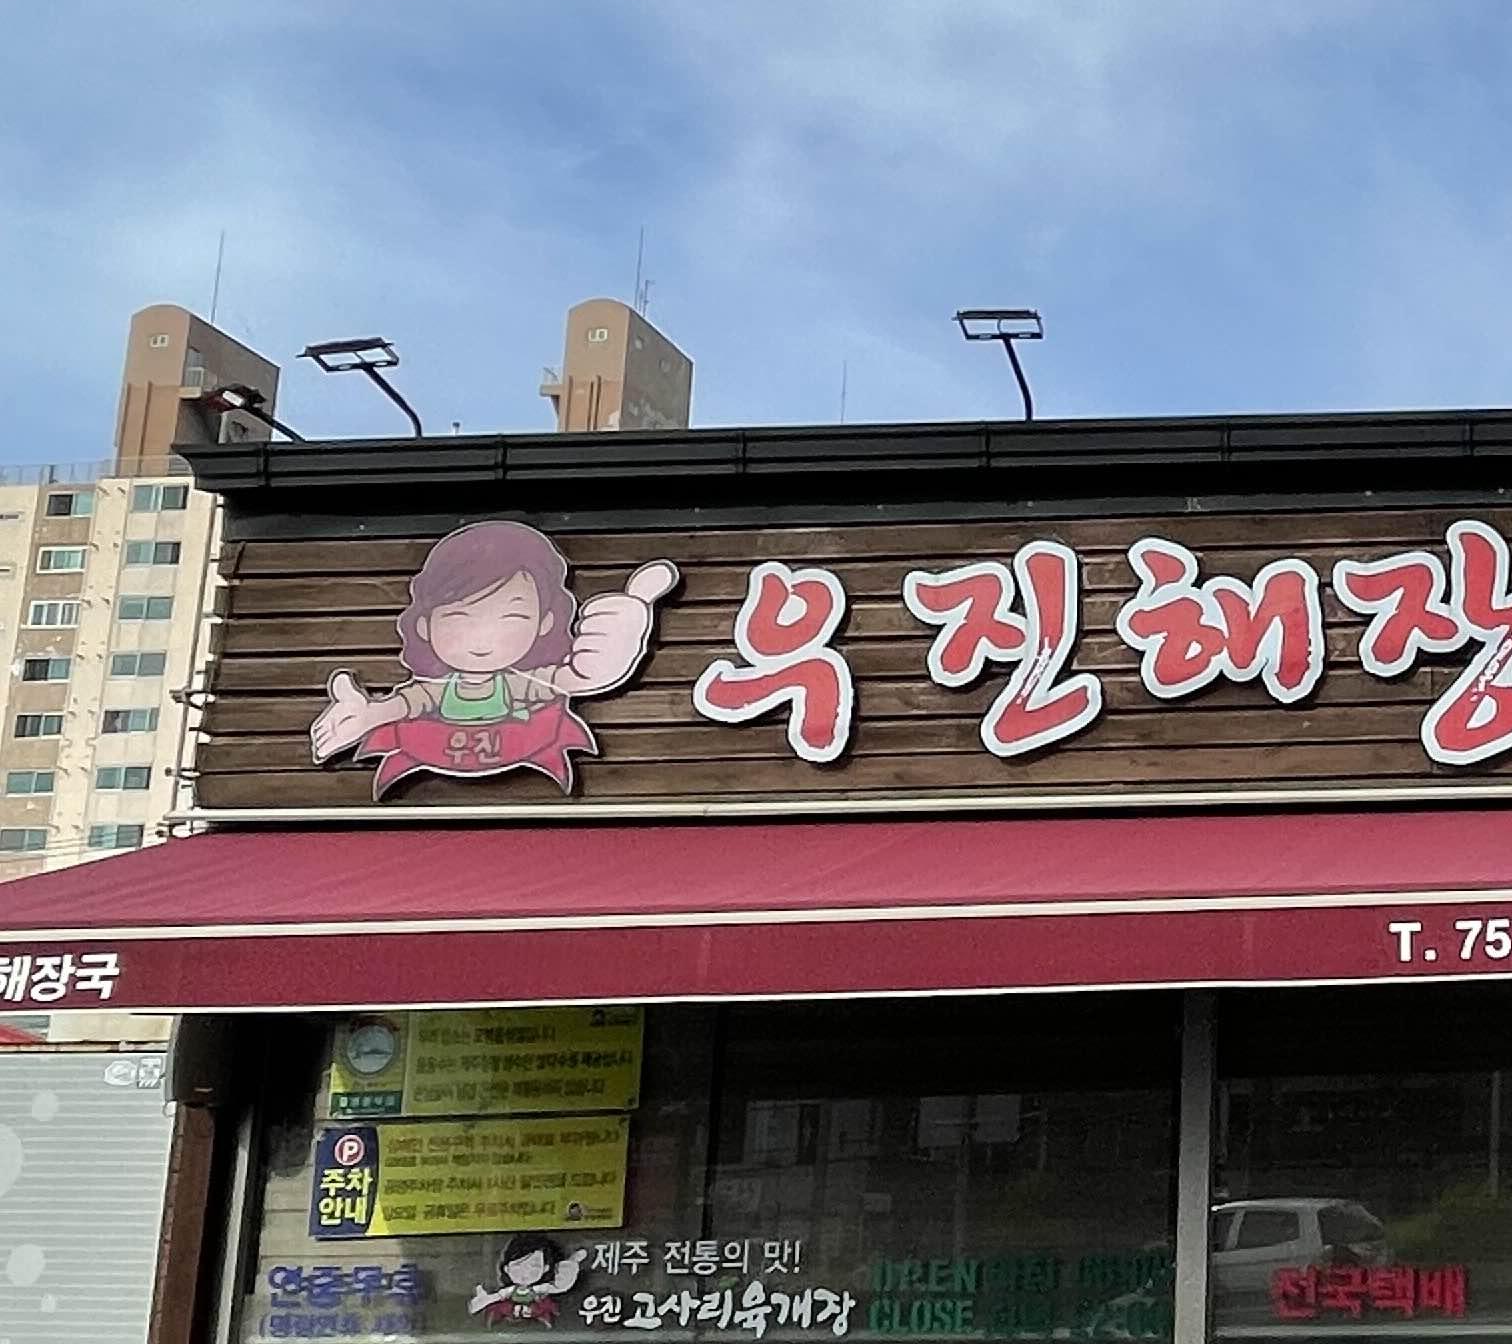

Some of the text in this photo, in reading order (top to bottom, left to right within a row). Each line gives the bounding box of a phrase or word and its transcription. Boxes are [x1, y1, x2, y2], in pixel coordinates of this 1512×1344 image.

[445, 731, 501, 764] 우진
[1388, 921, 1437, 962] T.
[0, 952, 120, 1002] 해장국
[344, 1141, 358, 1161] P
[320, 1168, 373, 1197] 주차
[318, 1196, 369, 1226] 안내
[592, 1239, 801, 1276] 제주 전통의 맛!
[579, 1280, 856, 1338] 우진 고사리육개장
[1272, 1264, 1466, 1320] 전국택배
[868, 1299, 974, 1334] CLOSE
